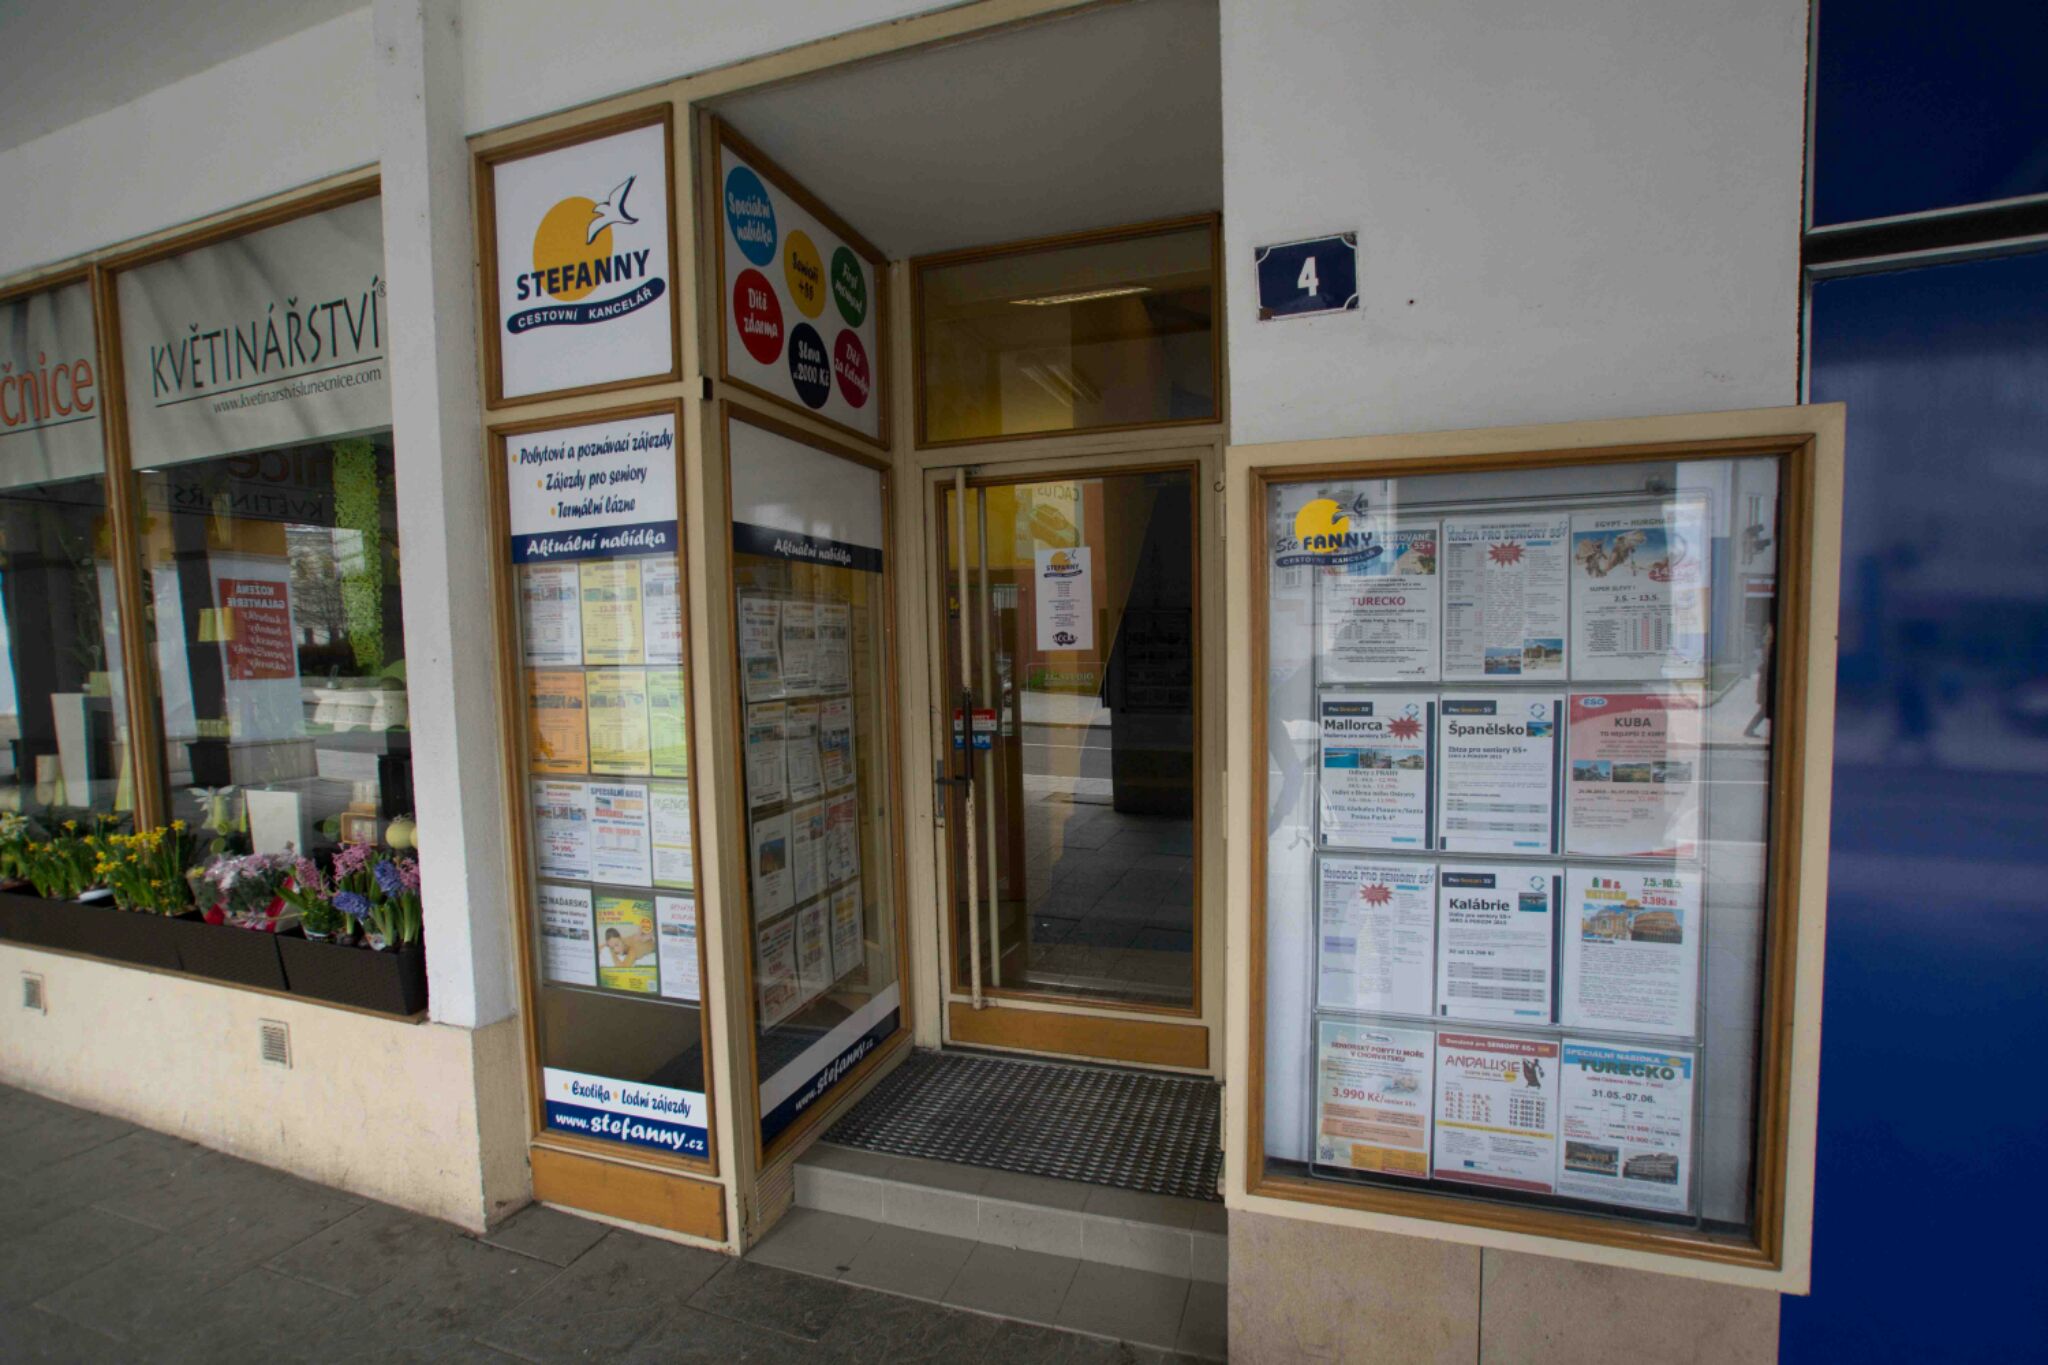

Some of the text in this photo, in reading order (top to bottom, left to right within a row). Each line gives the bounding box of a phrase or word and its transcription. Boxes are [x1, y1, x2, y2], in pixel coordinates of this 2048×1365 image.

[516, 249, 650, 300] STEFANNY
[1297, 256, 1319, 297] 4
[517, 286, 652, 329] CESTOVNÍ KANCELÁŘ
[744, 310, 778, 338] zdarma
[151, 275, 380, 398] KVĚTINÁŘSTVÍ
[213, 366, 382, 414] www.kvetinarstvislunecnice.com
[519, 428, 673, 465] Pobytové a poznávací zájezdy
[546, 464, 647, 492] Zájezdy pro seniory
[557, 496, 603, 518] Termální
[1595, 520, 1620, 528] EGYPT
[526, 529, 666, 557] Aktuální nabídka
[1303, 532, 1373, 550] FANNY
[1482, 530, 1501, 541] PRO
[1503, 529, 1547, 541] SENIORY
[774, 538, 851, 566] Aktuální nabídka
[1046, 563, 1079, 572] STEFANNY
[1350, 596, 1406, 606] TURECKO
[1324, 719, 1383, 731] Mallorca
[1448, 720, 1524, 738] Španělsko
[1614, 717, 1652, 728] KUBA
[1360, 870, 1377, 881] PRO
[1379, 872, 1417, 884] SENIORY
[1449, 898, 1511, 912] Kalábrie
[1487, 1040, 1520, 1050] SENIORY
[1445, 1054, 1520, 1072] ANDALUSIE
[1565, 1048, 1661, 1063] SPECIÁLNÍ NABÍDKA
[795, 1038, 874, 1112] www.stefanny.cz
[1580, 1059, 1675, 1081] TURECKO
[571, 1081, 610, 1103] Exotika
[651, 1094, 691, 1118] zájezdy
[1332, 1087, 1365, 1101] 3.990
[1592, 1088, 1656, 1104] 31.05.-07.06.
[555, 1113, 704, 1150] www.stefanny.cz
